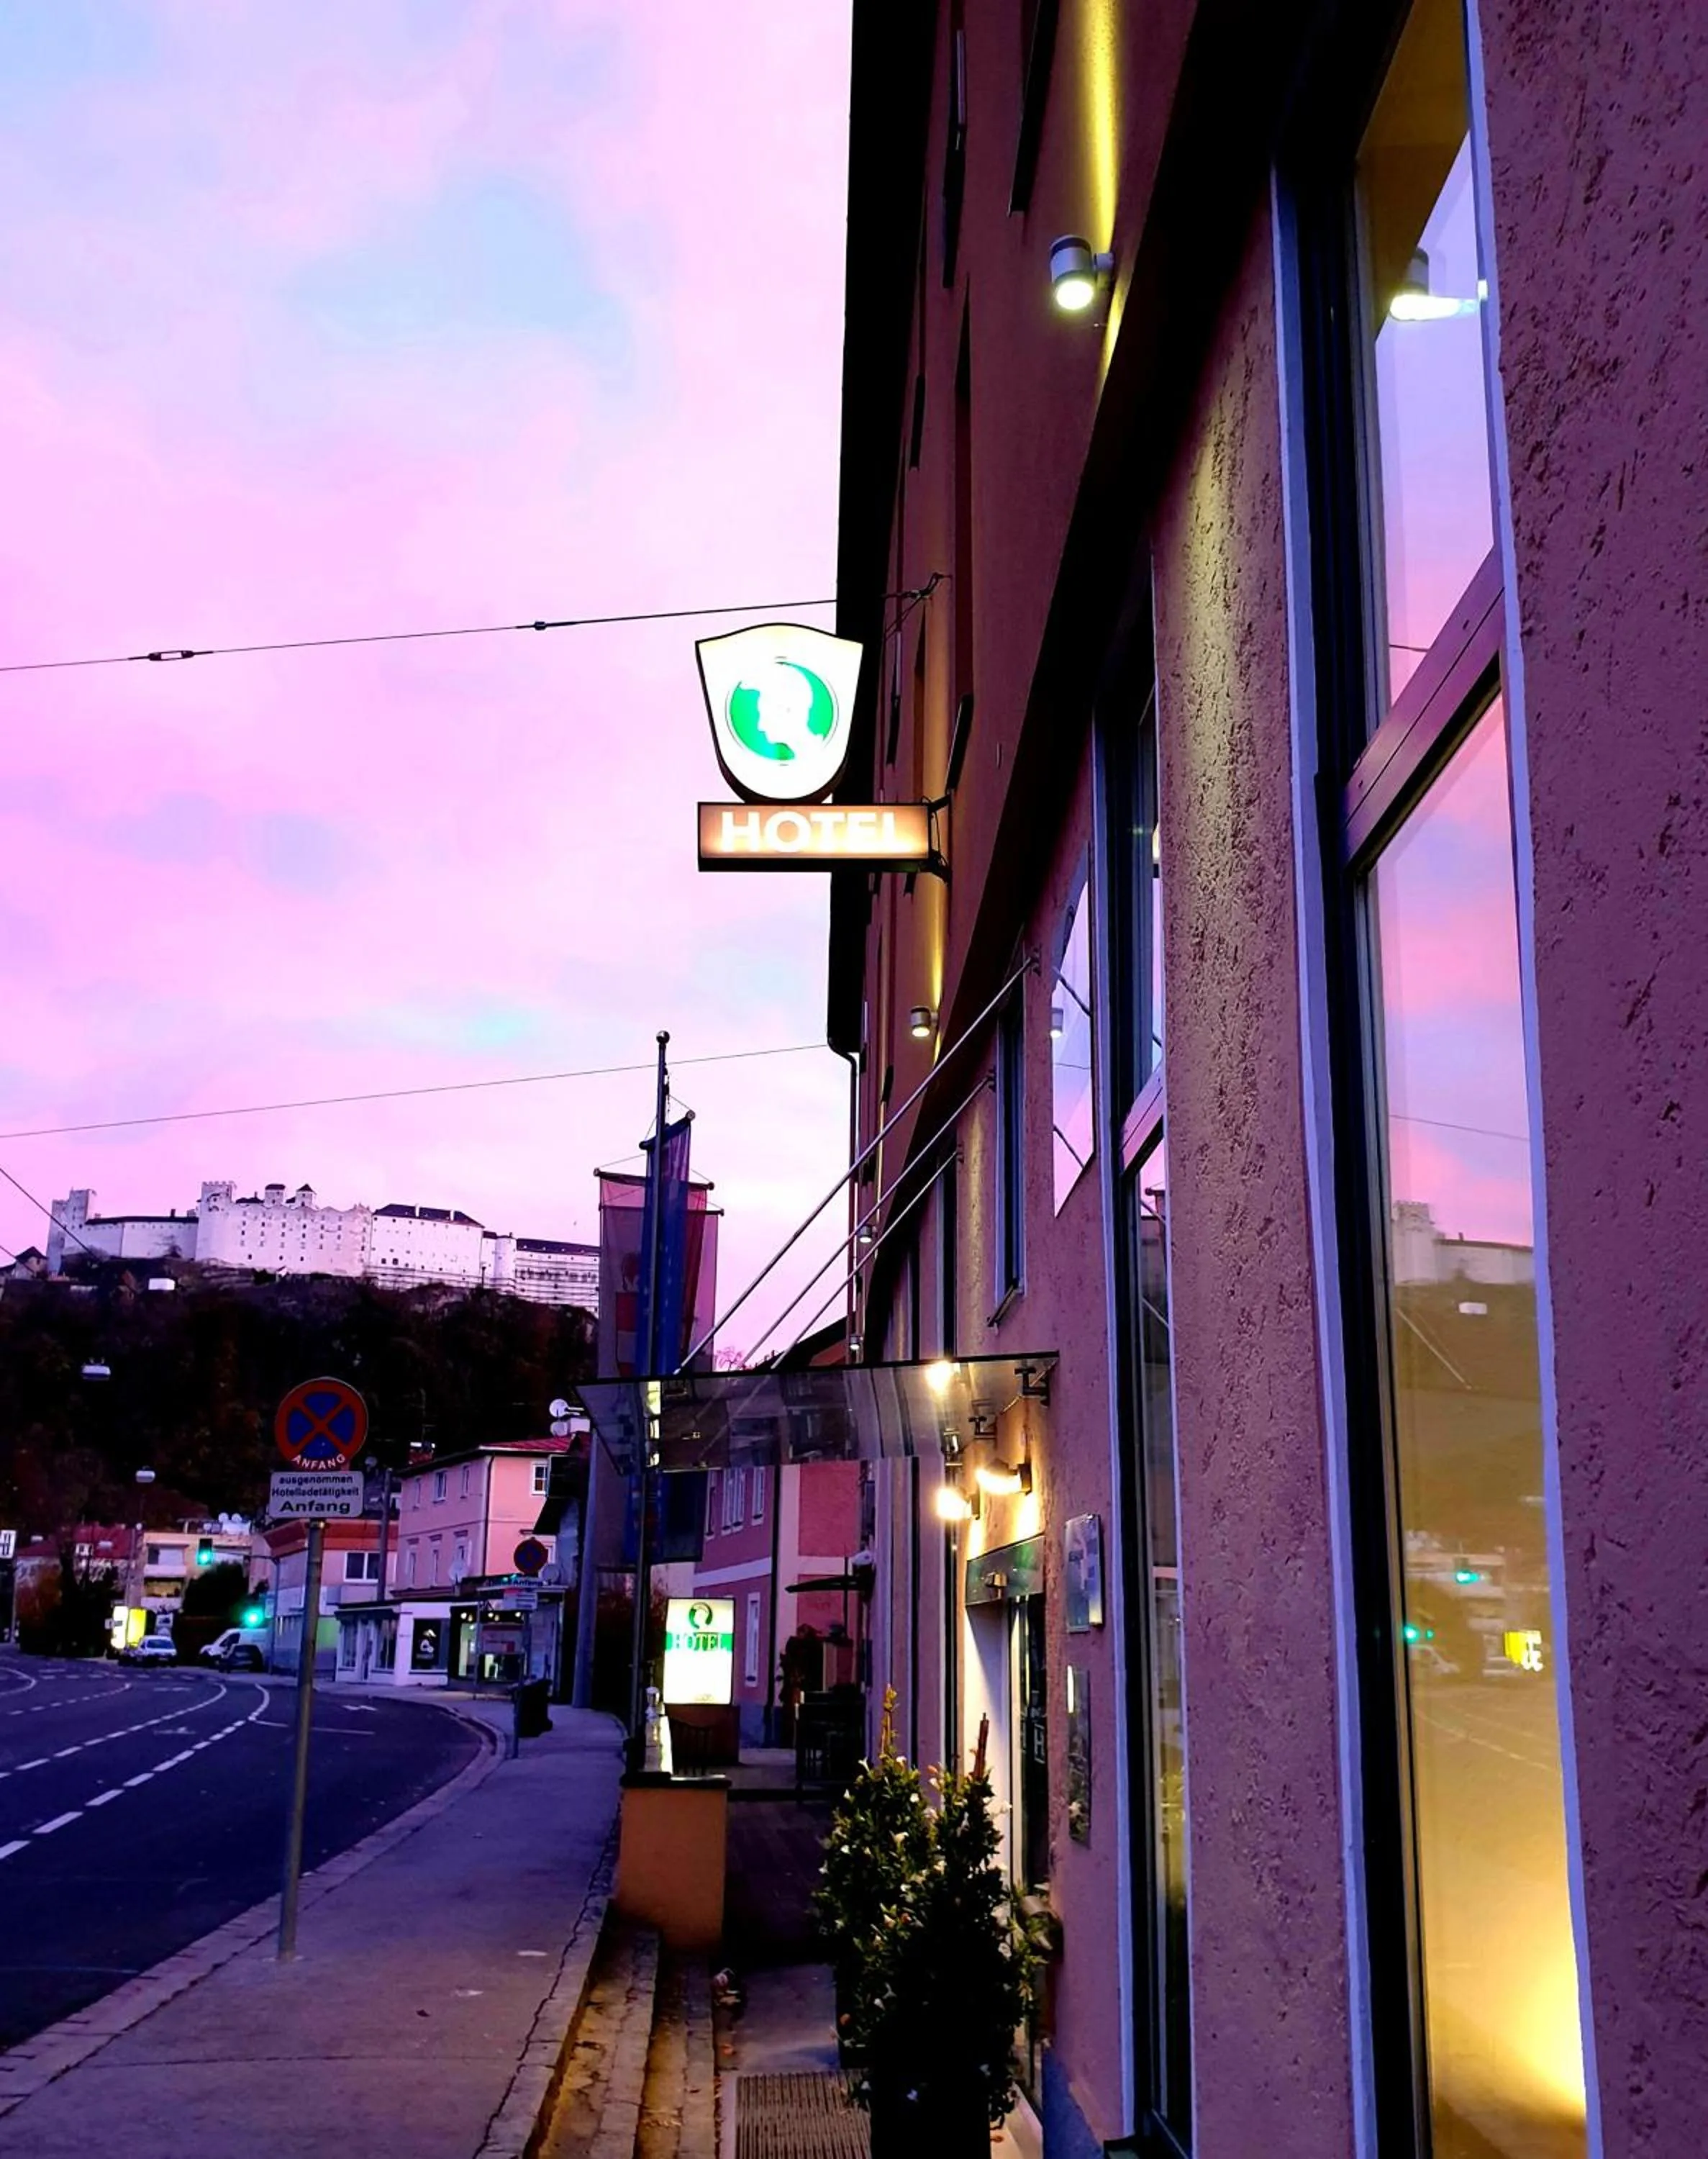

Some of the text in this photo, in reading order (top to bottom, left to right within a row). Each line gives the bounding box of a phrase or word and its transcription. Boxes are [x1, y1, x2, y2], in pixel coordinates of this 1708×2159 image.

[721, 811, 912, 853] HOTEL
[291, 1453, 345, 1470] ANFANG
[279, 1476, 353, 1485] ausgenommen
[279, 1500, 350, 1514] Anfang
[672, 1632, 727, 1651] HOTEL
